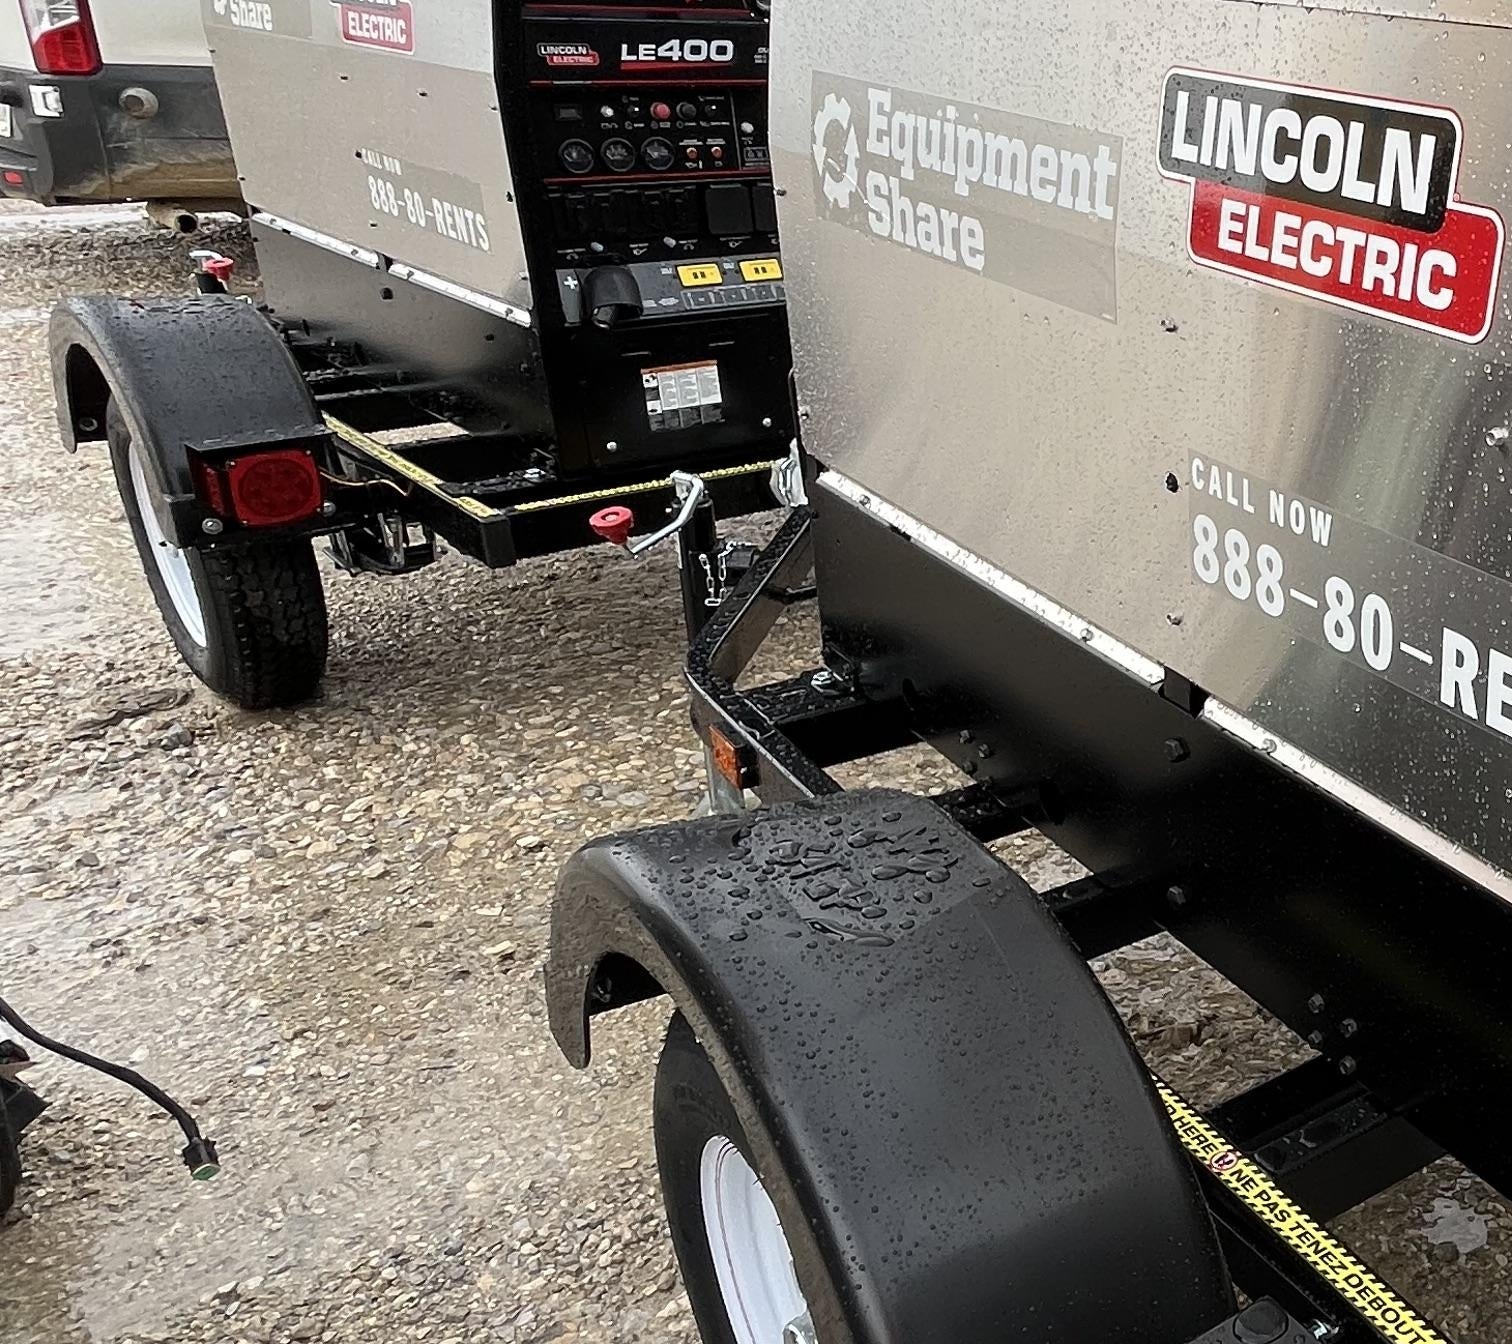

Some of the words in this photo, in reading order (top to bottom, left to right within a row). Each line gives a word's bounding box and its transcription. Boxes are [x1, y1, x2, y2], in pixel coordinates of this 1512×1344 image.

[347, 11, 407, 44] ELECTRIC
[541, 45, 587, 55] LINCOLN
[620, 39, 734, 61] LE400
[866, 88, 1116, 220] Equipment
[1172, 90, 1437, 214] LINCOLN
[368, 175, 490, 251] 888-80-RENTS
[866, 175, 985, 272] Share
[1218, 198, 1457, 311] ELECTRIC
[1191, 457, 1255, 514] CALL
[1269, 490, 1333, 546] NOW
[1174, 1116, 1218, 1154] HERE
[1230, 1168, 1257, 1192] NE
[1254, 1189, 1292, 1224] PAS
[1289, 1221, 1349, 1275] TENEZ
